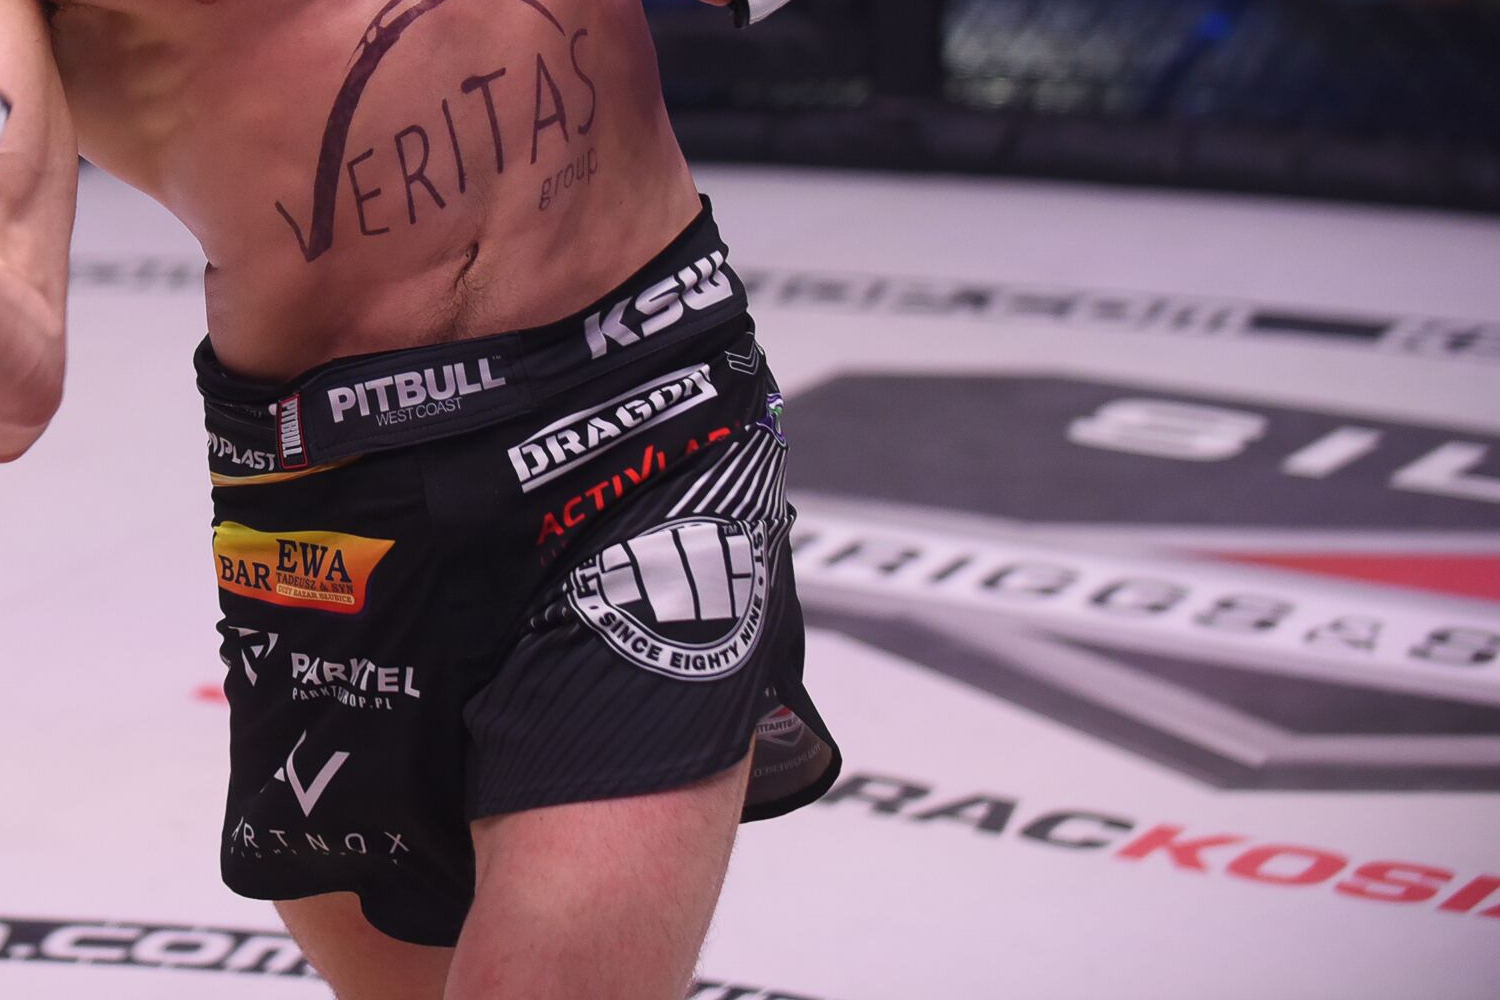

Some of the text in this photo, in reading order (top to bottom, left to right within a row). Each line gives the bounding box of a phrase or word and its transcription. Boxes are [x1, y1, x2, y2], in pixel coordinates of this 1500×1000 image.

[275, 27, 596, 263] VERITAS
[538, 147, 599, 212] group
[584, 250, 734, 361] KSW
[326, 358, 506, 424] PITBULL
[375, 397, 463, 428] WEST COAST
[217, 436, 277, 472] PLAST
[281, 401, 303, 459] PITBULL
[218, 538, 353, 592] BAR EWA
[599, 593, 764, 671] SINCE EIGHTY NINE
